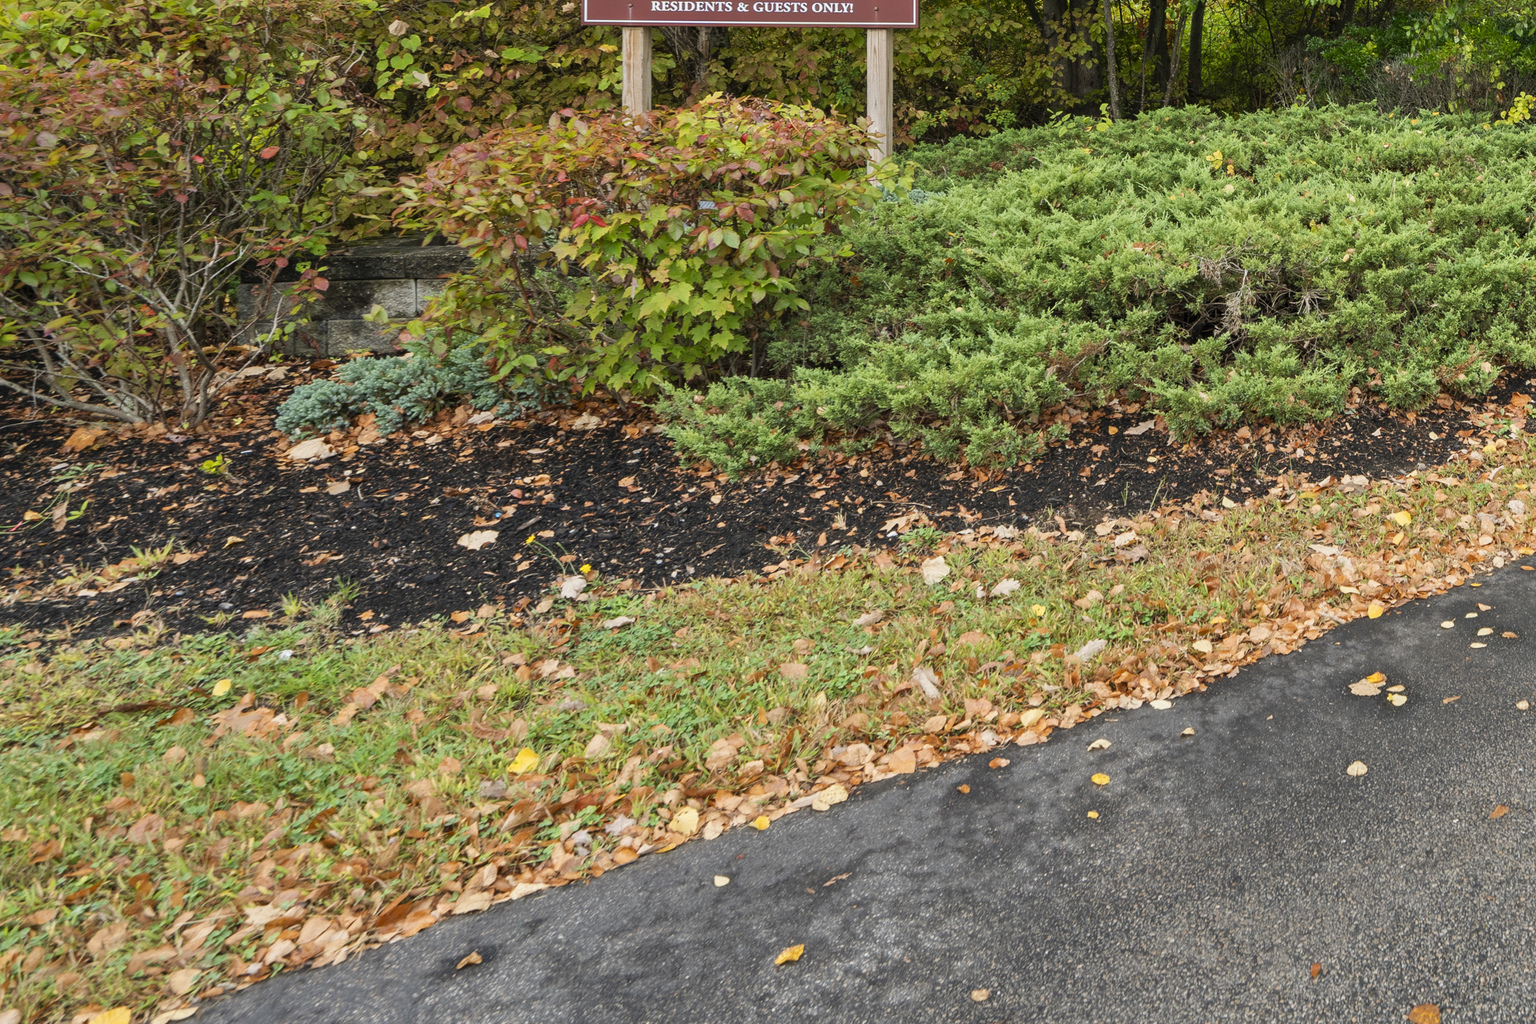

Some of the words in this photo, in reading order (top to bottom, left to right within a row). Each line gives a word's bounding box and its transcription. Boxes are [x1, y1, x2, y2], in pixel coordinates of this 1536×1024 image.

[651, 0, 733, 13] RESIDENTS
[736, 2, 749, 13] &
[753, 1, 808, 13] GUESTS
[811, 2, 854, 14] ONLY!
